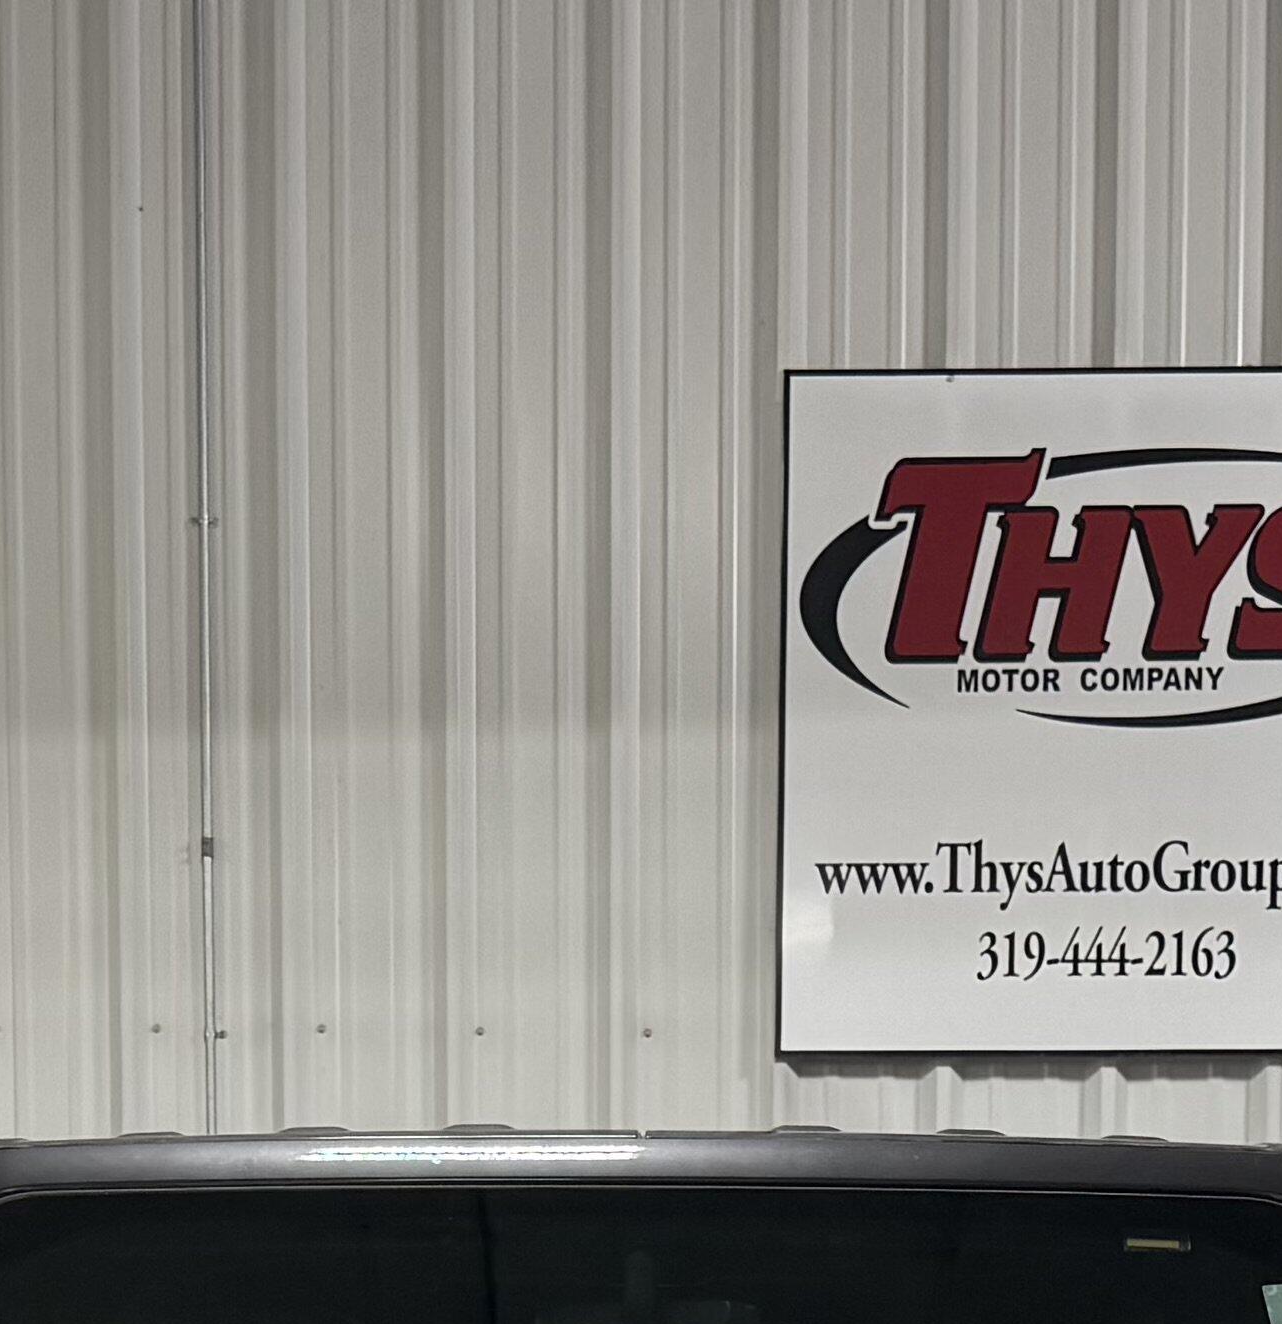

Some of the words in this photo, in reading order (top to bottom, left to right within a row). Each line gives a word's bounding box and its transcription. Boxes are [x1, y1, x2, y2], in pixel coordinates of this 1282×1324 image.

[956, 667, 1061, 693] MOTOR
[1079, 665, 1225, 693] COMPANY
[976, 926, 1237, 982] 319-444-2163
